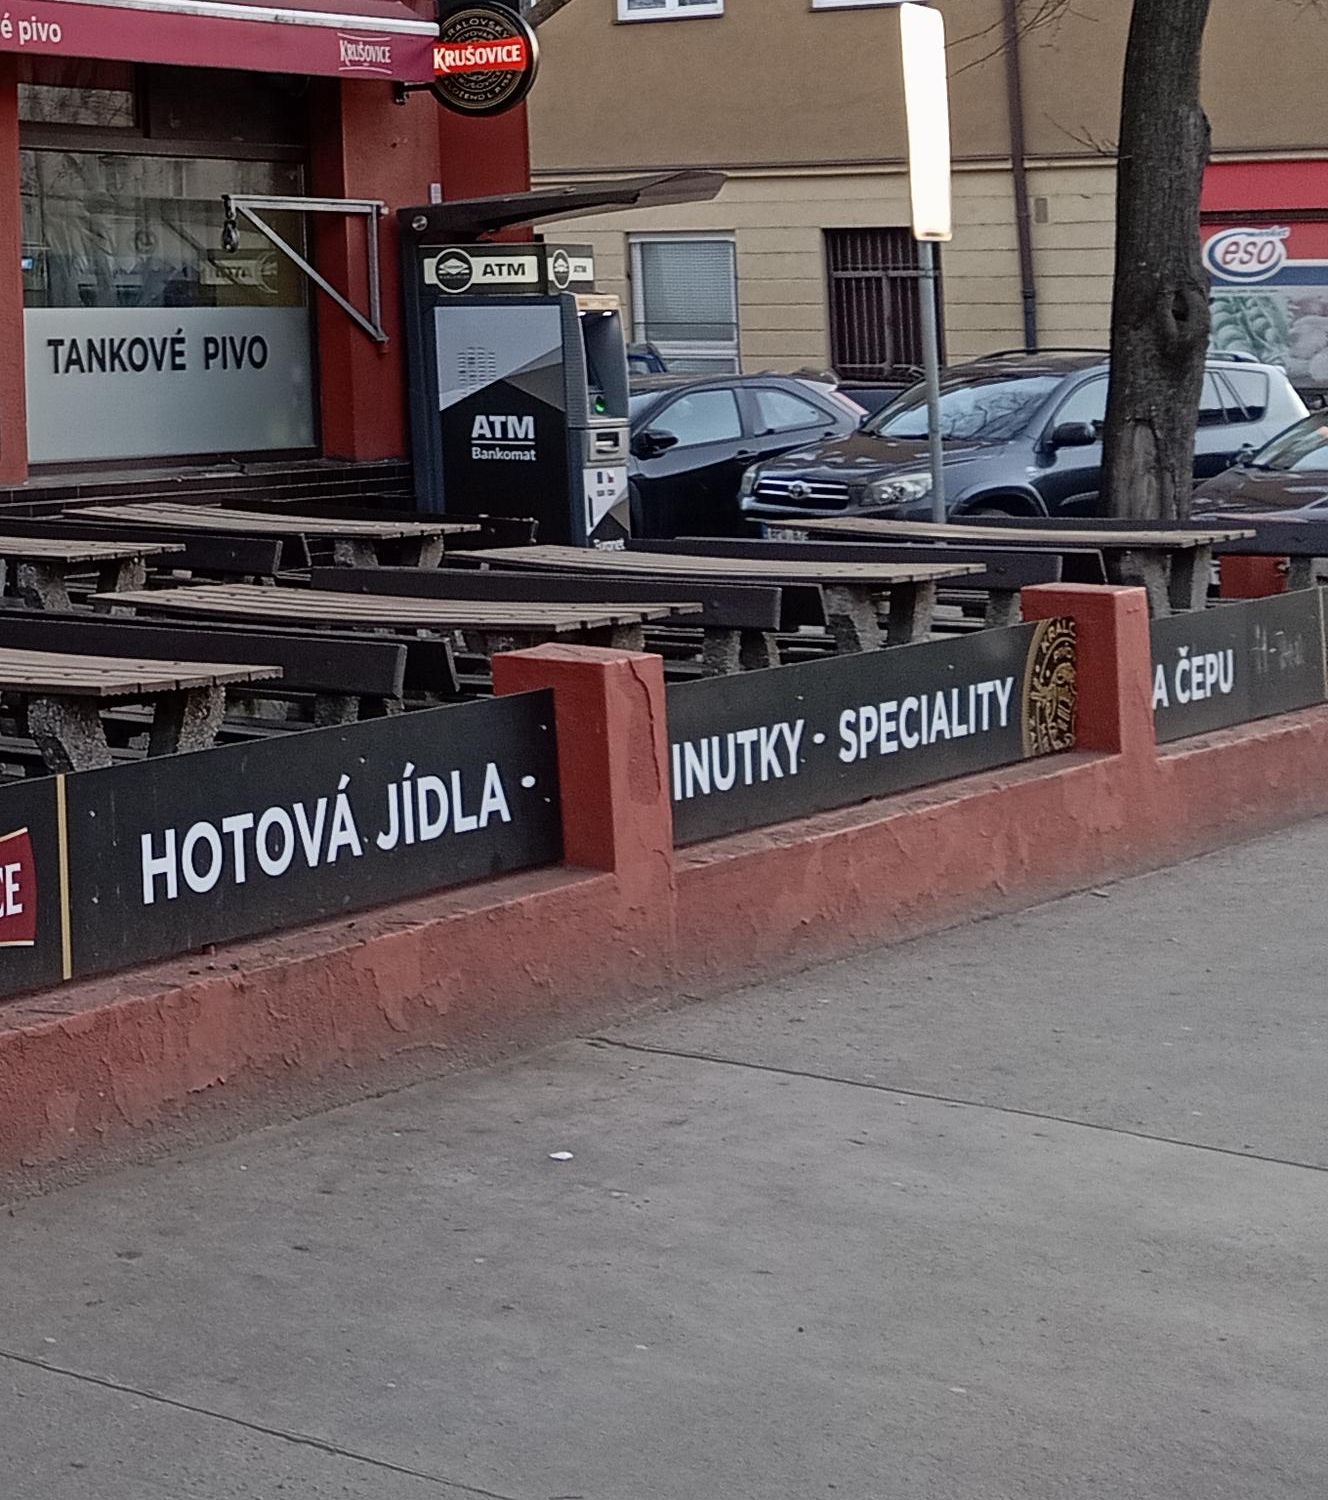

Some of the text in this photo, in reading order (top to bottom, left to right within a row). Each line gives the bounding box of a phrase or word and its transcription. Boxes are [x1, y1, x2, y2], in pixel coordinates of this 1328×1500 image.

[18, 15, 62, 45] pivo
[339, 39, 392, 66] KRUŠOVICE
[433, 45, 521, 72] KRUŠOVICE
[1222, 240, 1276, 266] eso
[482, 262, 526, 276] ATM
[47, 328, 269, 375] TANKOVÉ PIVO
[471, 415, 535, 440] ATM
[471, 447, 537, 461] Bankomat
[1175, 646, 1234, 705] ČEPU
[838, 677, 1014, 763] SPECIALITY
[140, 761, 512, 906] HOTOVÁ JÍDLA
